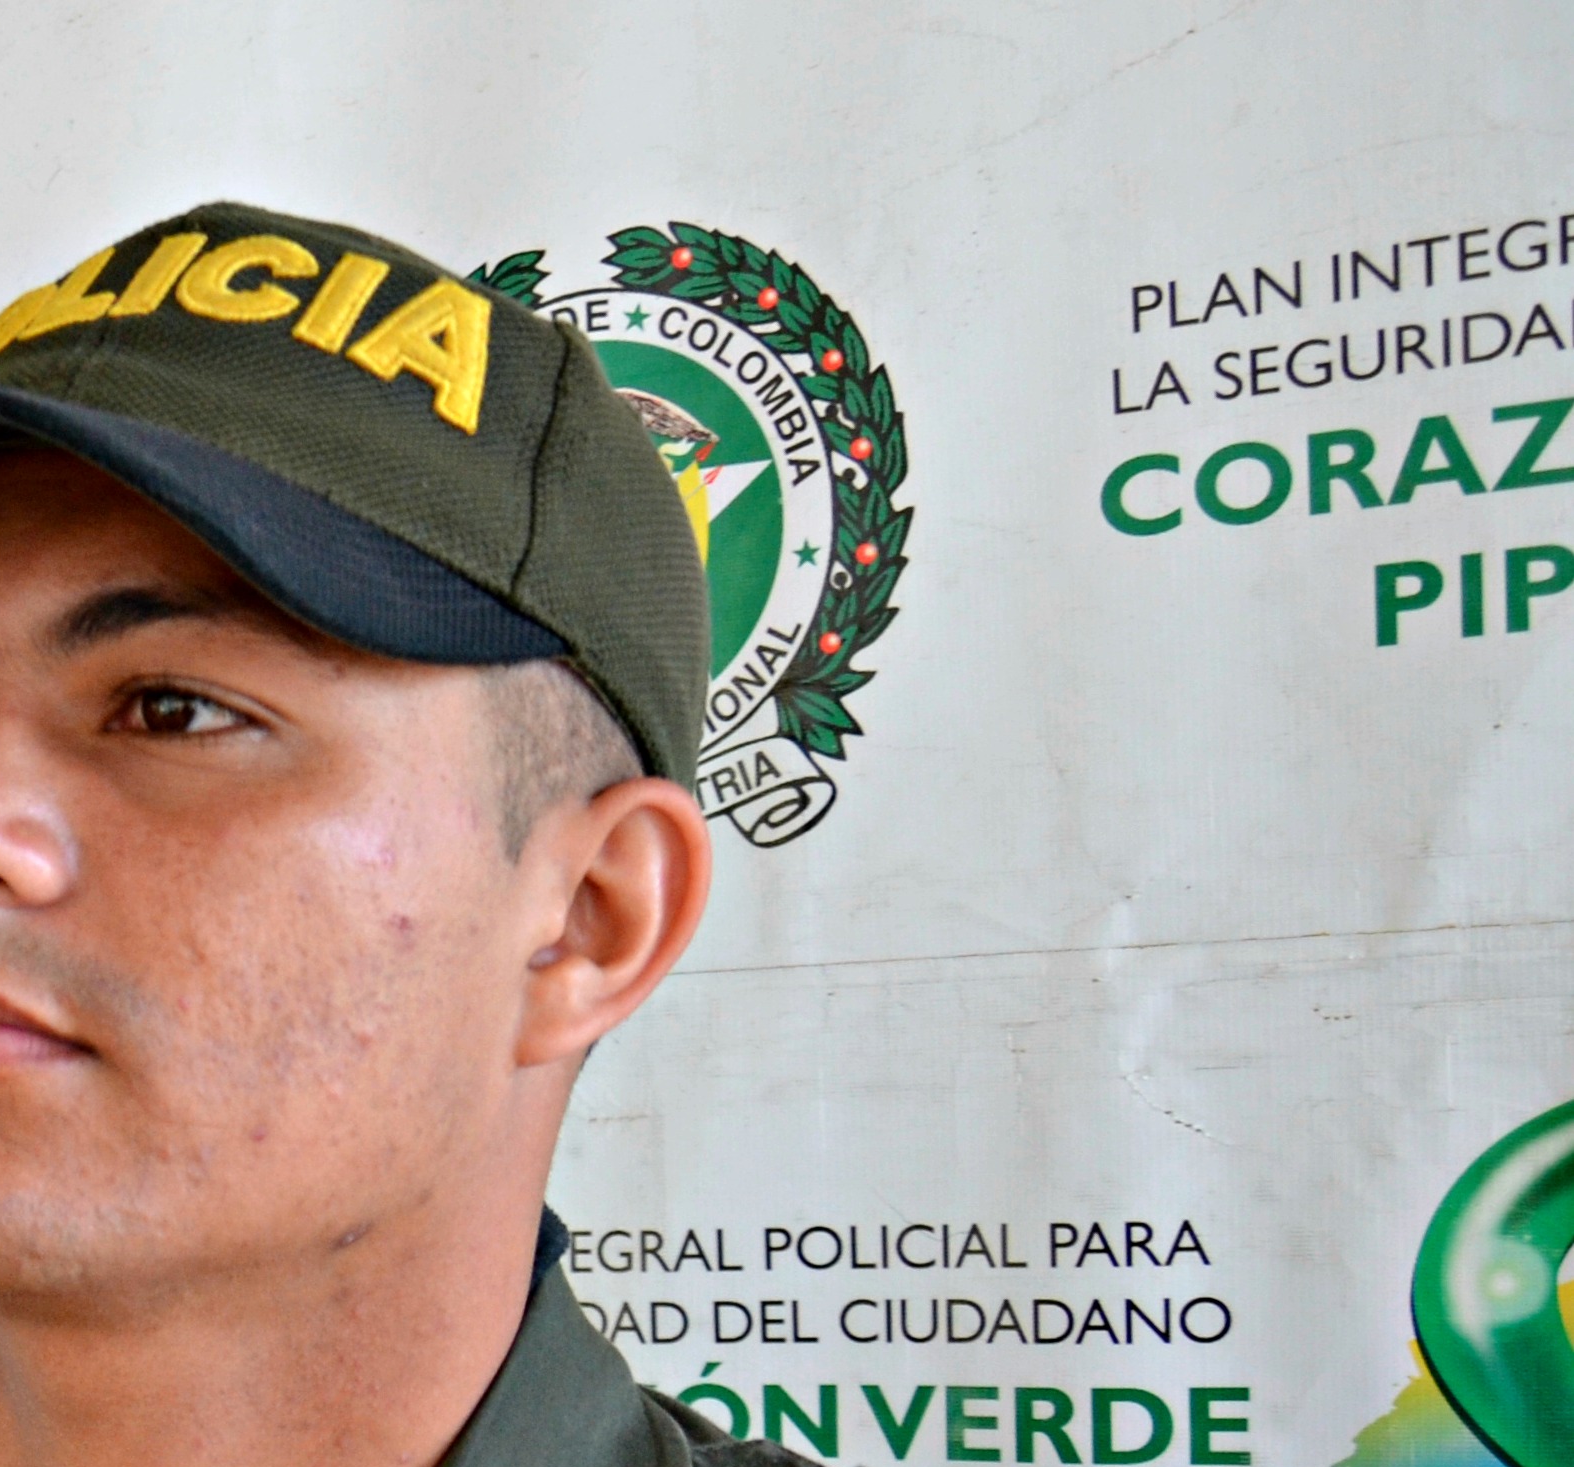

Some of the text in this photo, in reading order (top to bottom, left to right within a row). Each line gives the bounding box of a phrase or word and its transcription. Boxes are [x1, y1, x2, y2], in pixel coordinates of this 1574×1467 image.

[1131, 260, 1303, 333] PLAN
[658, 306, 824, 487] COLOMBIA
[1112, 303, 1574, 415] LA SEGURIDA
[704, 622, 804, 734] IONAL
[696, 750, 782, 812] TRIA
[570, 1219, 1212, 1274] EGRAL POLICIAL PARA
[713, 1300, 820, 1345] DEL
[839, 1296, 1234, 1346] CIUDADANO
[860, 1384, 1253, 1467] VERDE
